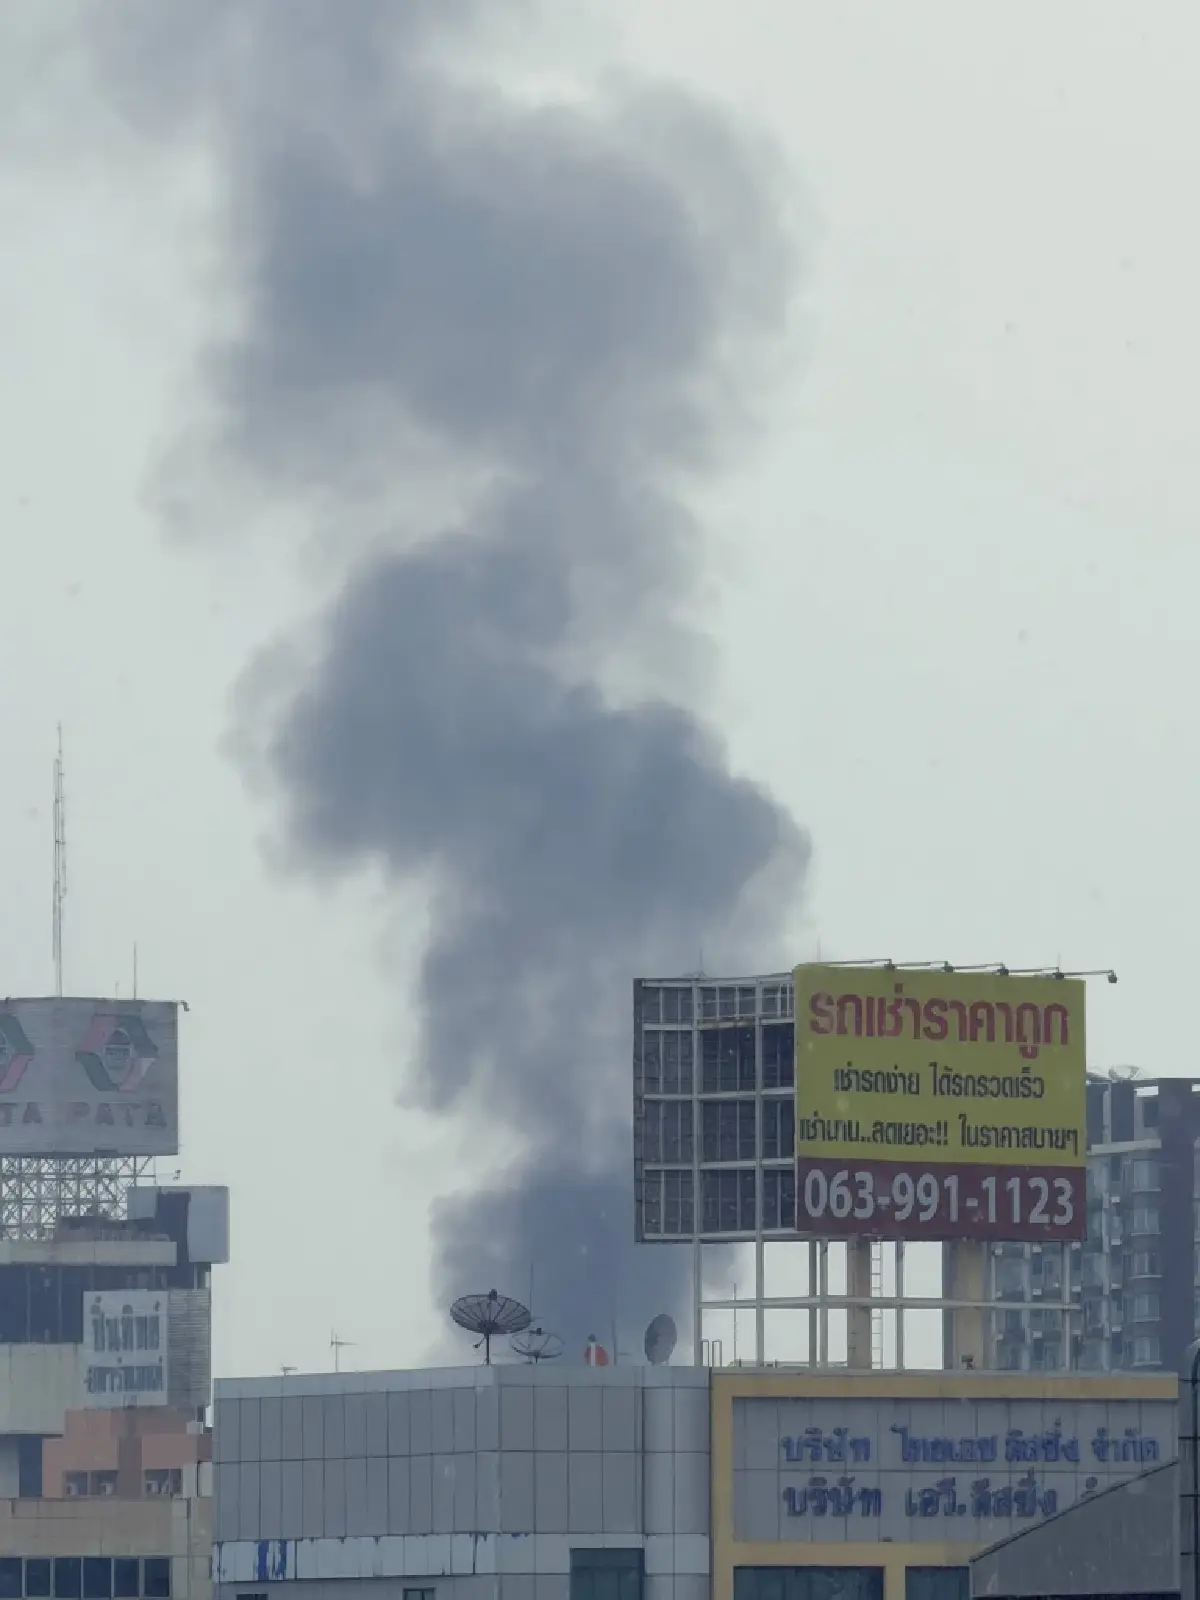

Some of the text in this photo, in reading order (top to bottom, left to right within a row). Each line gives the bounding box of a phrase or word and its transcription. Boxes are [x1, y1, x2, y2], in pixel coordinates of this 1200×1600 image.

[809, 983, 1069, 1059] รถเช่าราคาถูก
[834, 1061, 1045, 1098] เช่ารถง่าย ได้รถรวดเร็ว
[65, 1102, 167, 1127] PATA
[799, 1110, 1079, 1156] เช่านาน..ลดเยอะ!! ในราคาสบายๆ
[804, 1168, 1074, 1226] 063-991-1123
[780, 1427, 871, 1462] บริษัท
[1091, 1427, 1160, 1462] จำกัด
[782, 1476, 882, 1517] บริษัท
